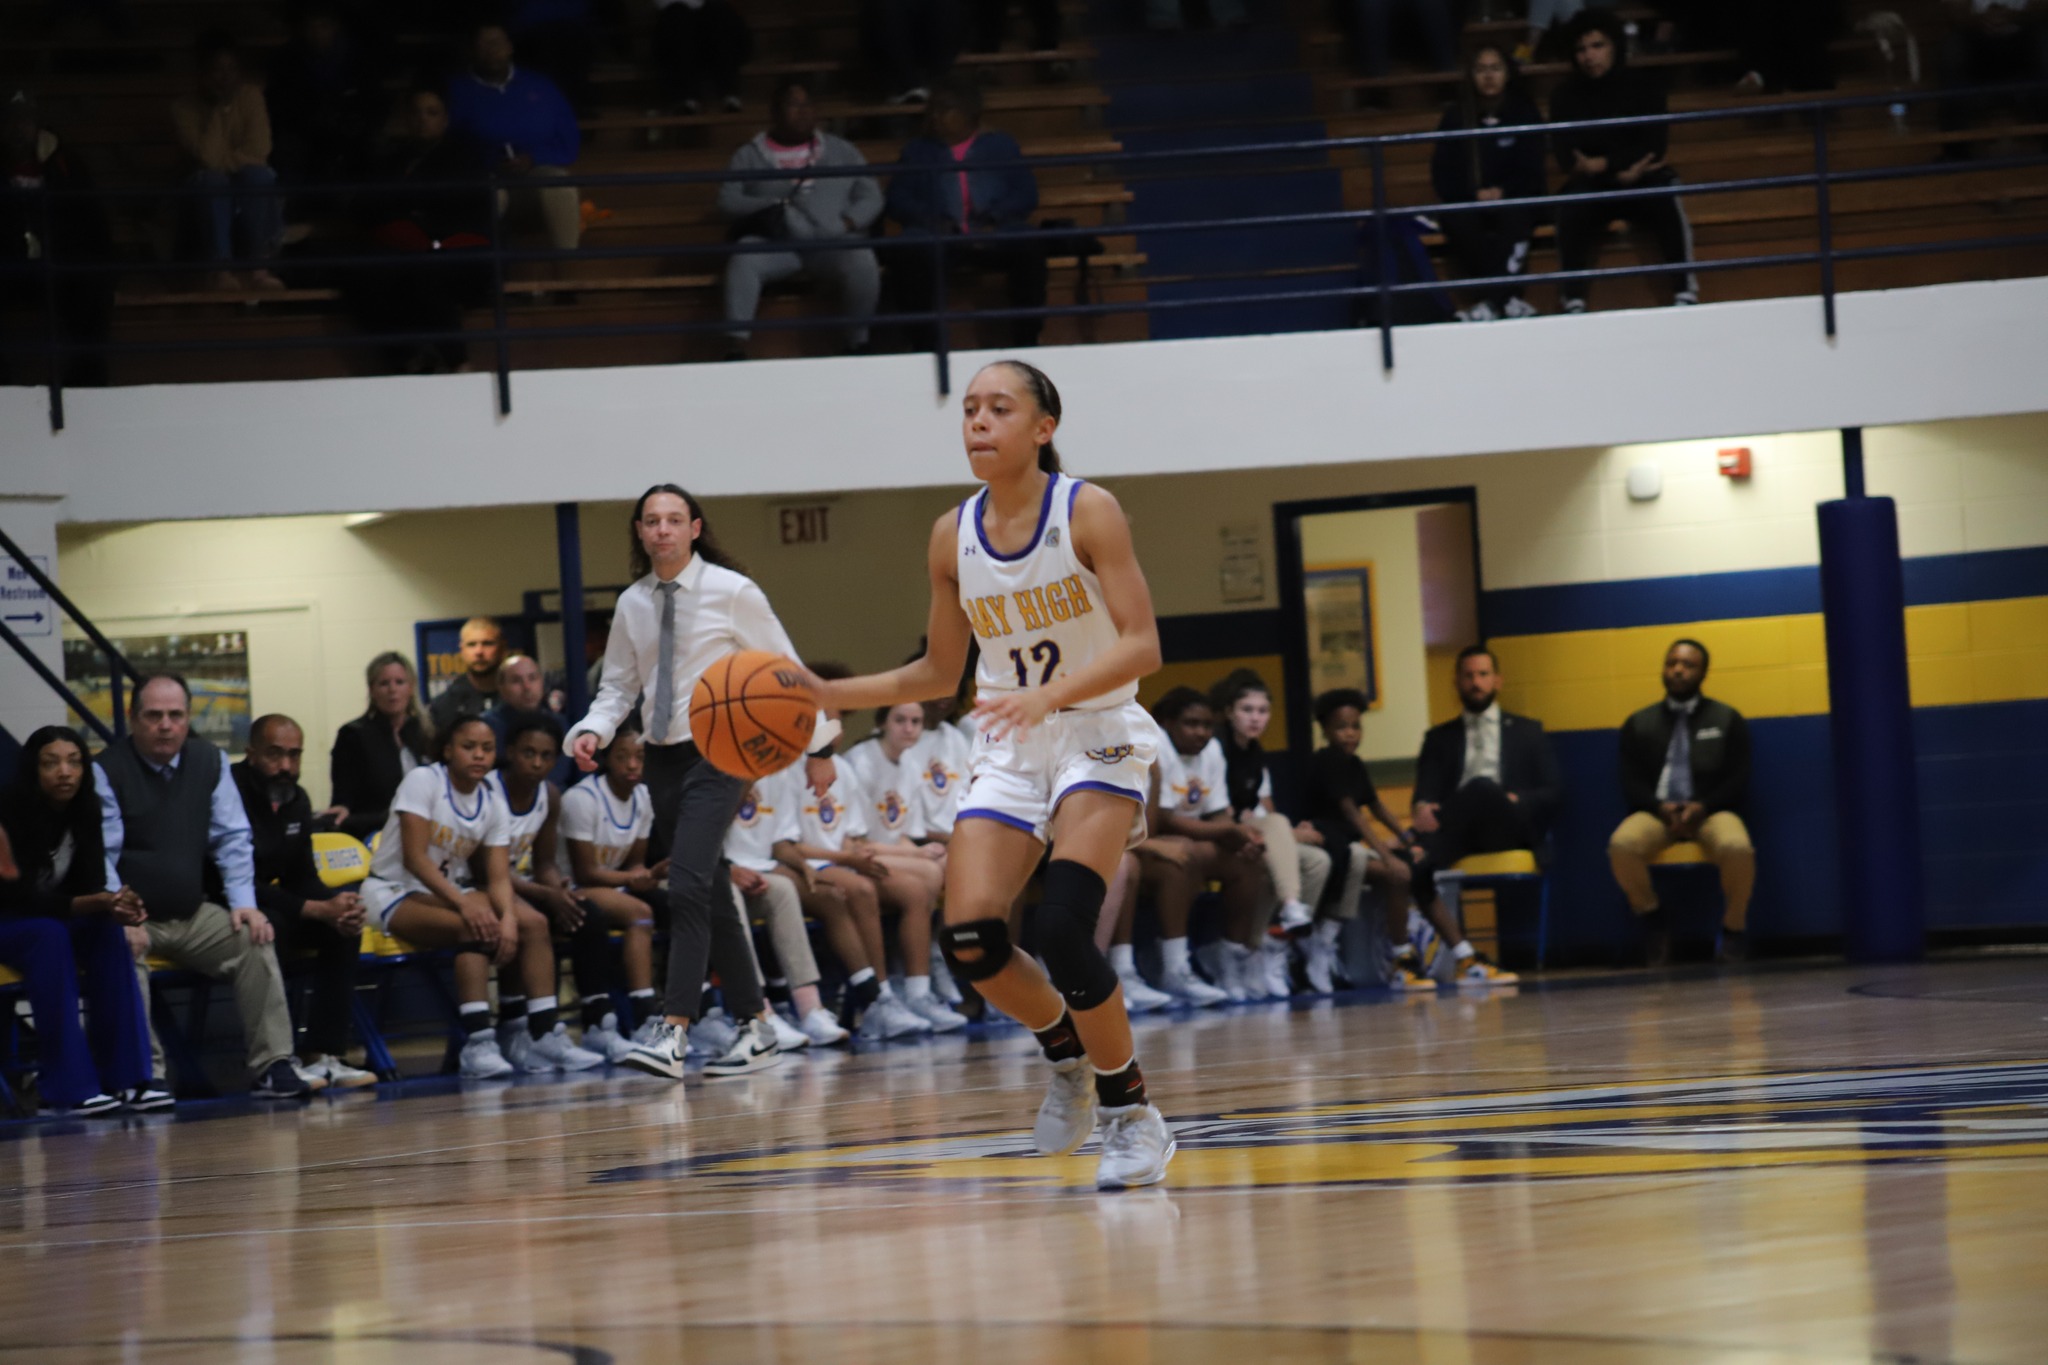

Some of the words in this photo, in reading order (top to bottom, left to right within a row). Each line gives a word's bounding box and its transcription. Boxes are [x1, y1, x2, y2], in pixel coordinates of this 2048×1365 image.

[780, 507, 829, 545] EXIT
[1013, 574, 1093, 631] HIGH
[1009, 639, 1062, 688] 12
[741, 731, 789, 771] BAY
